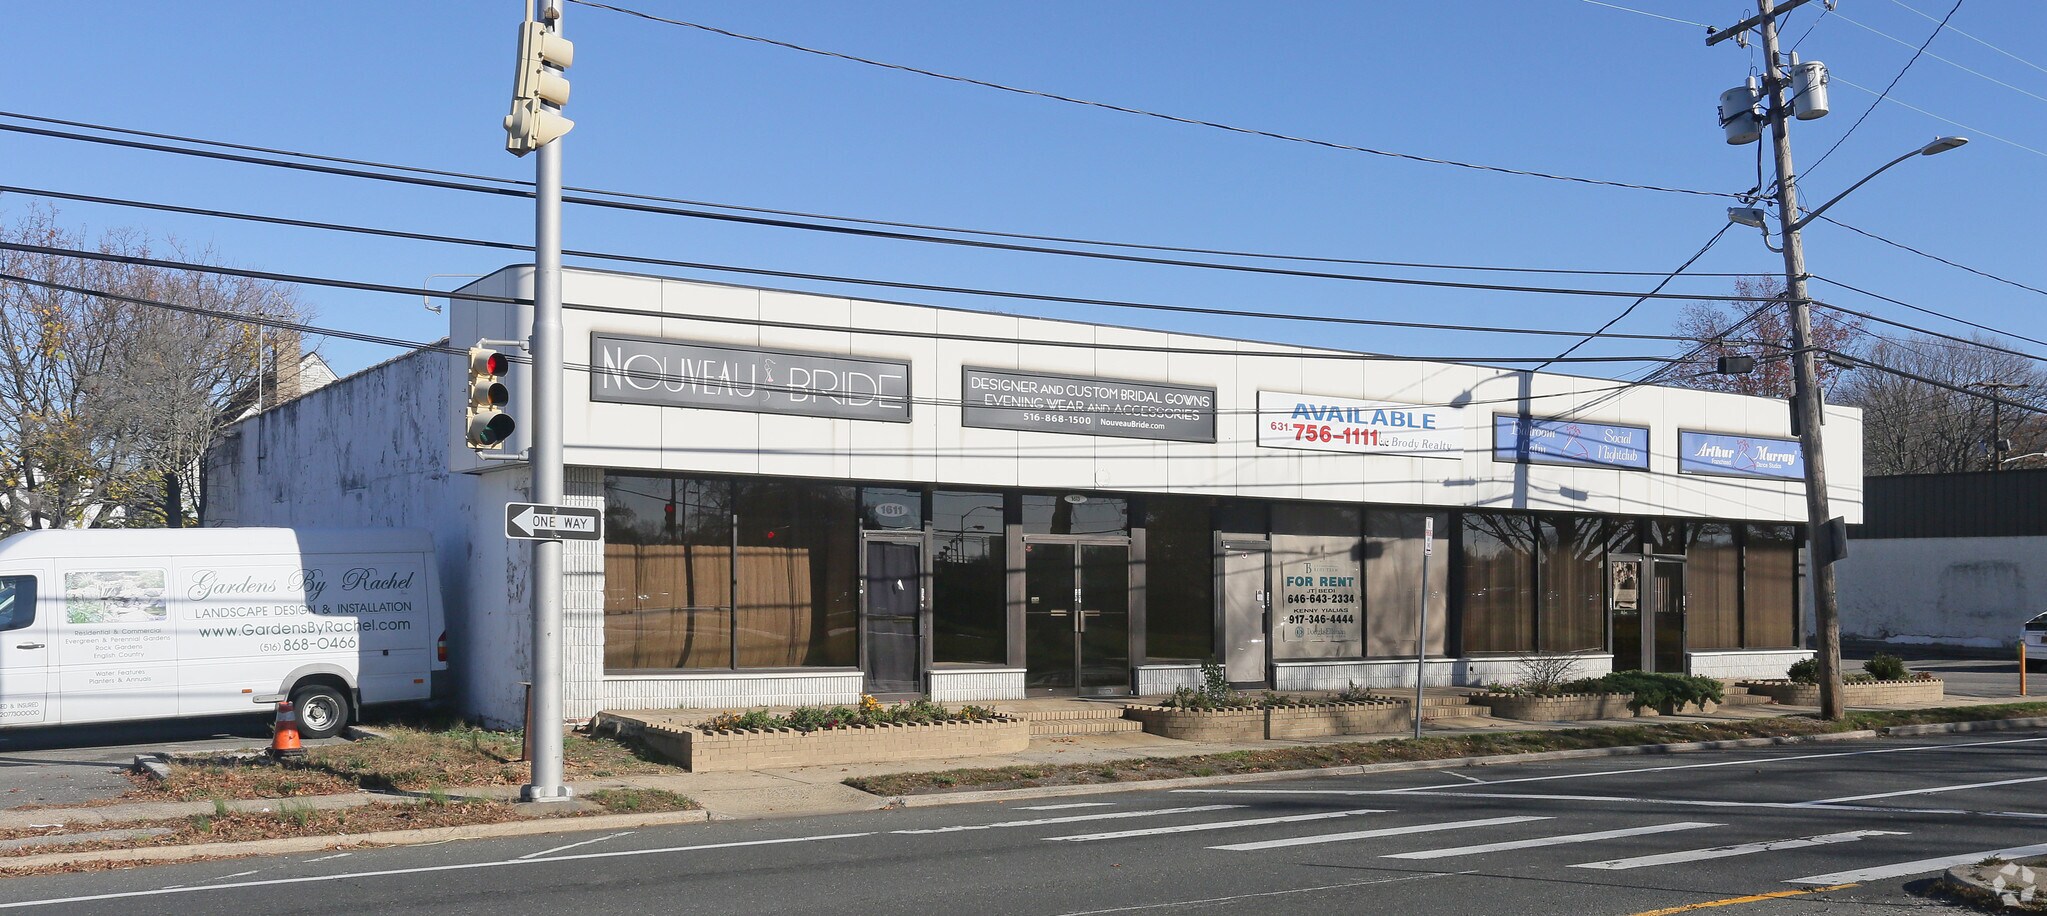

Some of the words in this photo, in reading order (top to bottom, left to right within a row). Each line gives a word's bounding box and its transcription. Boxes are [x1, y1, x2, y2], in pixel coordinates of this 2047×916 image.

[603, 345, 756, 398] NOUVEAU
[786, 367, 903, 409] BRIDE
[971, 376, 1038, 394] DESIGNER
[1040, 385, 1064, 396] AND
[1066, 384, 1119, 400] CUSTOM
[1120, 390, 1163, 404] BRIDAL
[1165, 393, 1211, 408] GOWNS
[984, 393, 1044, 409] EVENING
[1046, 398, 1084, 412] WEAR
[1087, 403, 1111, 413] AND
[1113, 404, 1201, 421] ACCESSORIES
[1023, 412, 1092, 425] 516-868-1500
[1100, 418, 1165, 430] NouveauBride.com
[1291, 403, 1436, 430] AVAILABLE
[1391, 437, 1420, 450] Brody
[1422, 439, 1452, 451] Realty
[1604, 429, 1632, 444] Social
[1598, 445, 1638, 463] Nightclub
[1695, 442, 1735, 459] Arthur
[1754, 446, 1795, 465] Murray
[881, 505, 903, 515] 1611
[533, 515, 556, 527] ONE
[564, 517, 588, 529] WAY
[187, 569, 277, 601] Gardens
[287, 568, 328, 602] By
[342, 567, 415, 591] Rachel
[1286, 576, 1313, 587] FOR
[1320, 576, 1354, 587] RENT
[1288, 594, 1354, 603] 646-643-2334
[195, 606, 268, 619] LANDSCAPE
[274, 604, 316, 615] DESIGN
[322, 604, 331, 614] &
[337, 602, 412, 613] INSTALLATION
[1289, 614, 1354, 624] 917-346-4444
[199, 619, 411, 637] www.GardensByRachel.com
[260, 642, 281, 652] (516)
[283, 636, 356, 652] 868-0466
[94, 652, 116, 660] English
[118, 651, 145, 659] Country
[17, 701, 39, 709] INSURED
